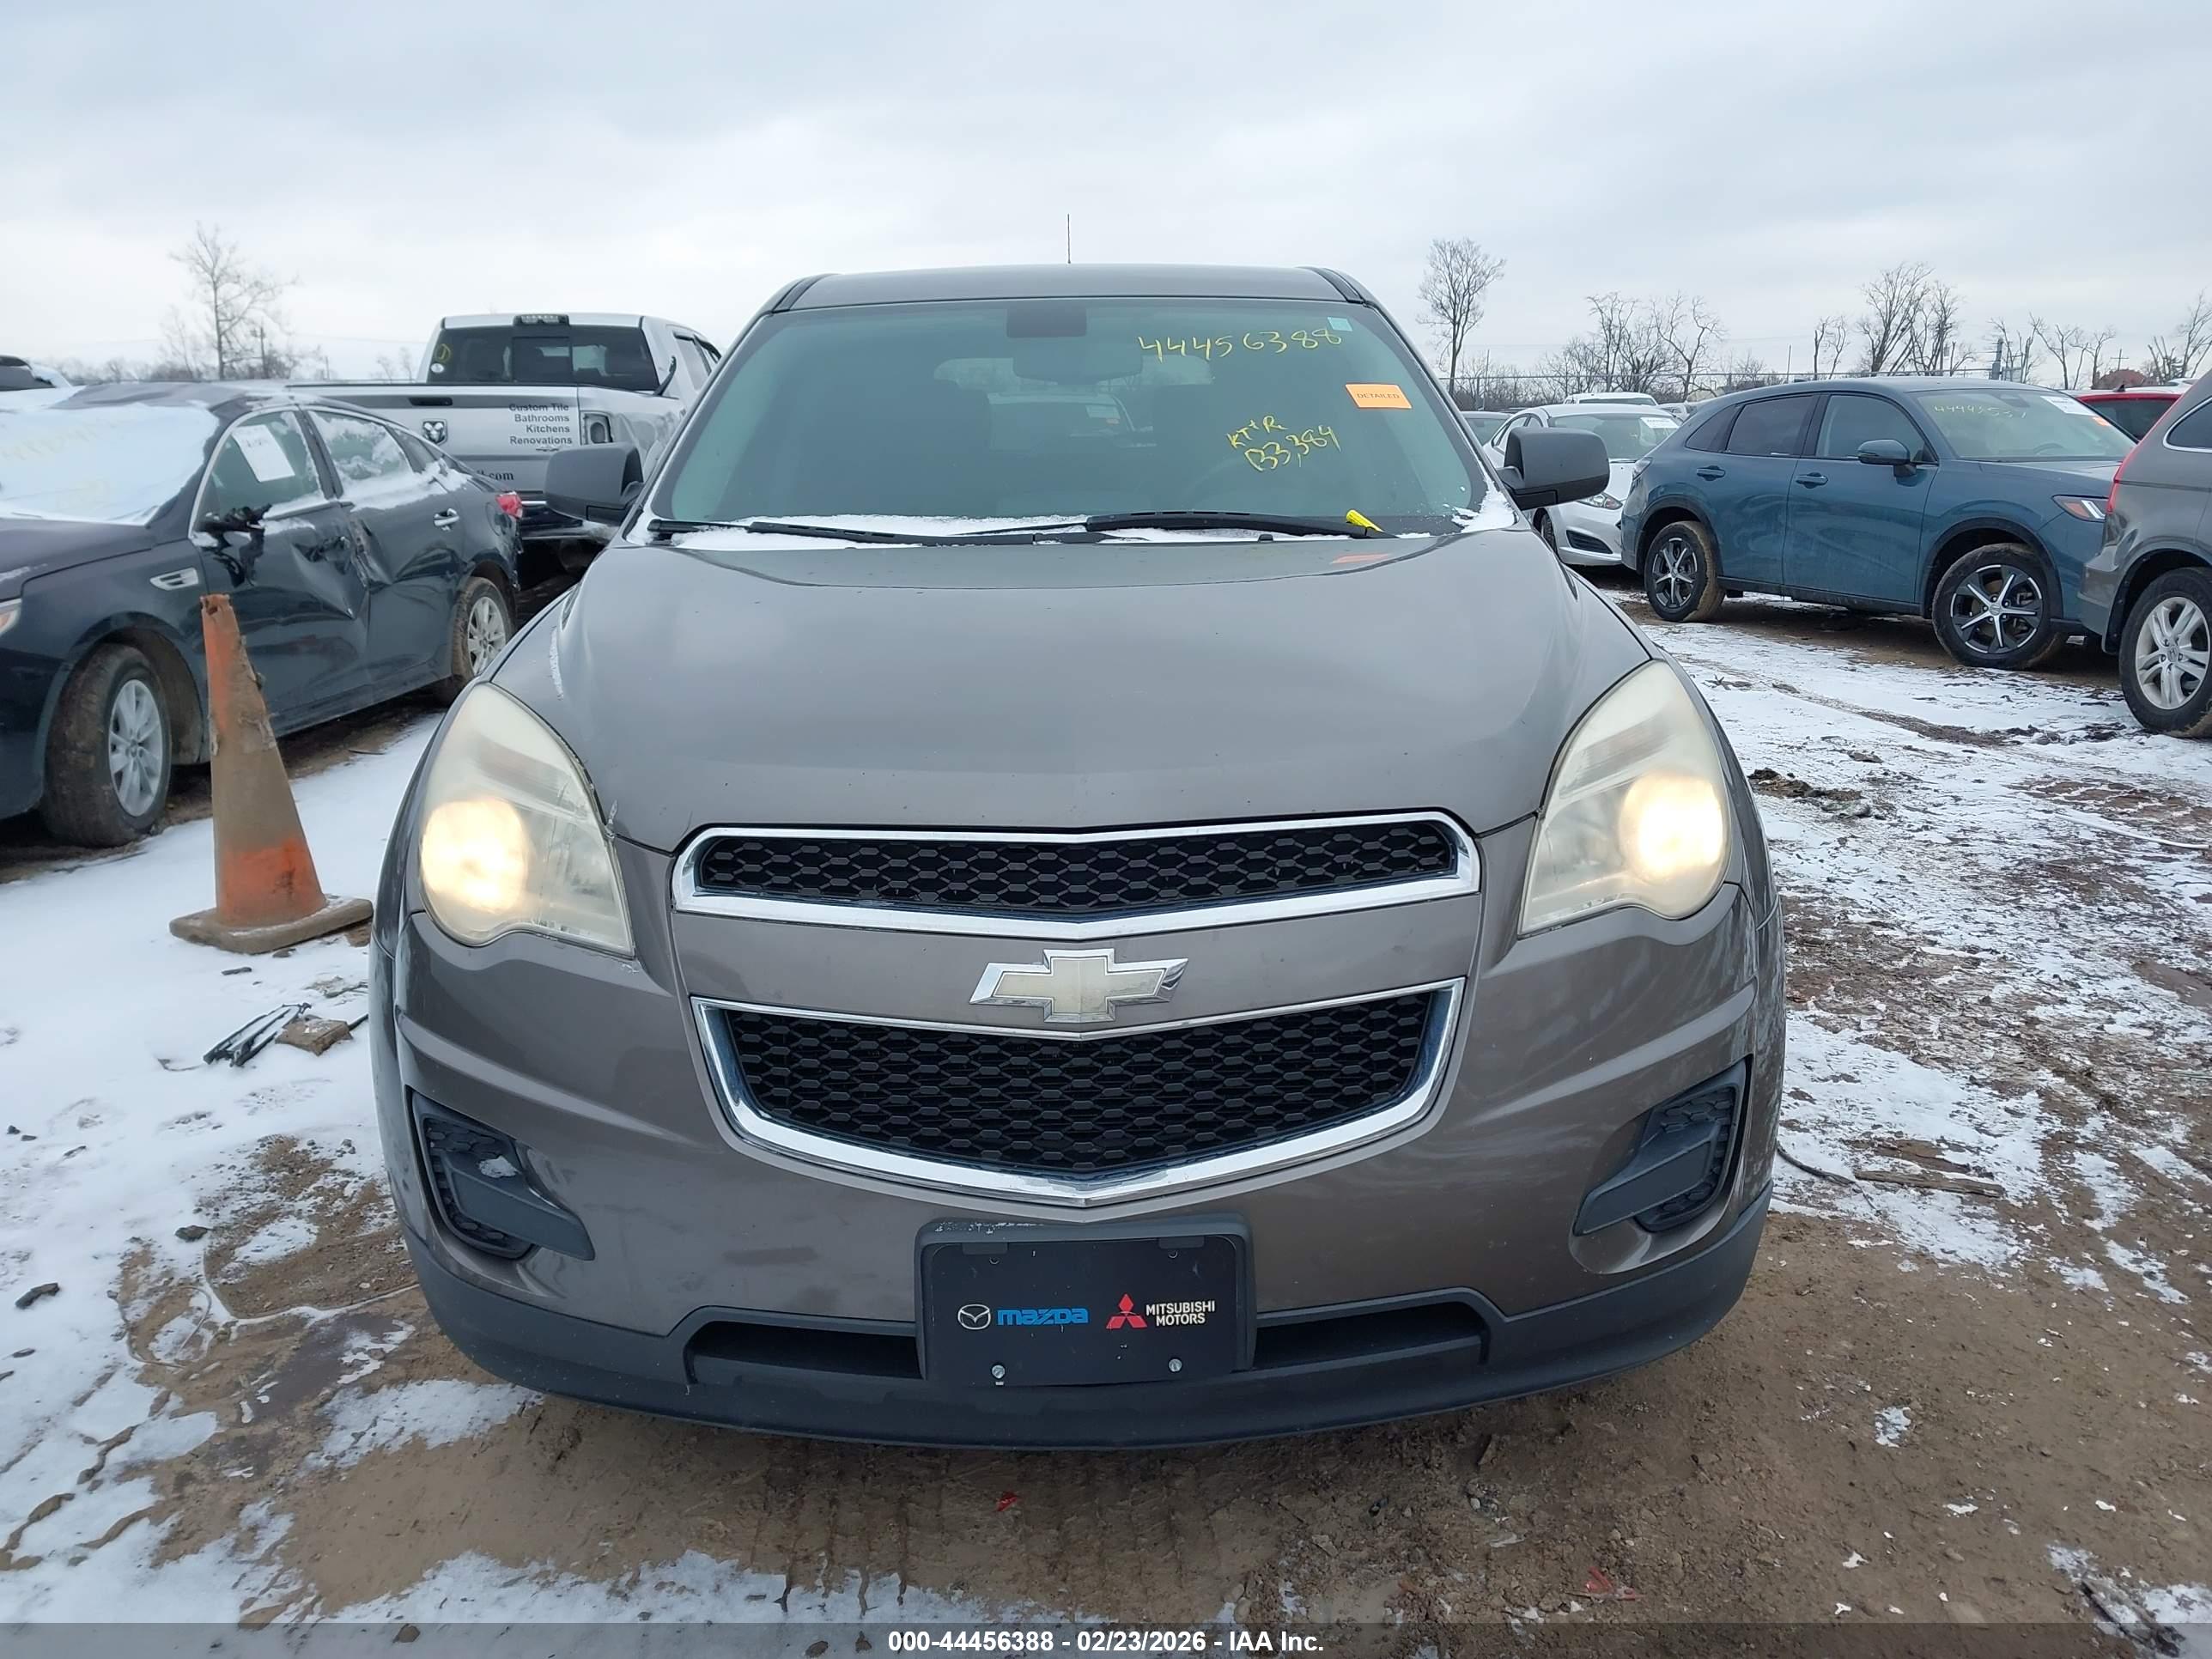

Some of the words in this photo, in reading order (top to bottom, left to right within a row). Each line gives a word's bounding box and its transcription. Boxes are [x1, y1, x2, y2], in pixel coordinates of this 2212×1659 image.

[1138, 329, 1342, 363] 44456388
[508, 403, 548, 411] Custom
[550, 403, 569, 411] Tile
[514, 414, 570, 422] Bathrooms
[526, 424, 570, 434] Kitchens
[509, 435, 573, 445] Renovations
[1146, 1300, 1216, 1316] MITSUBISHI
[1156, 1312, 1206, 1327] MOTORS
